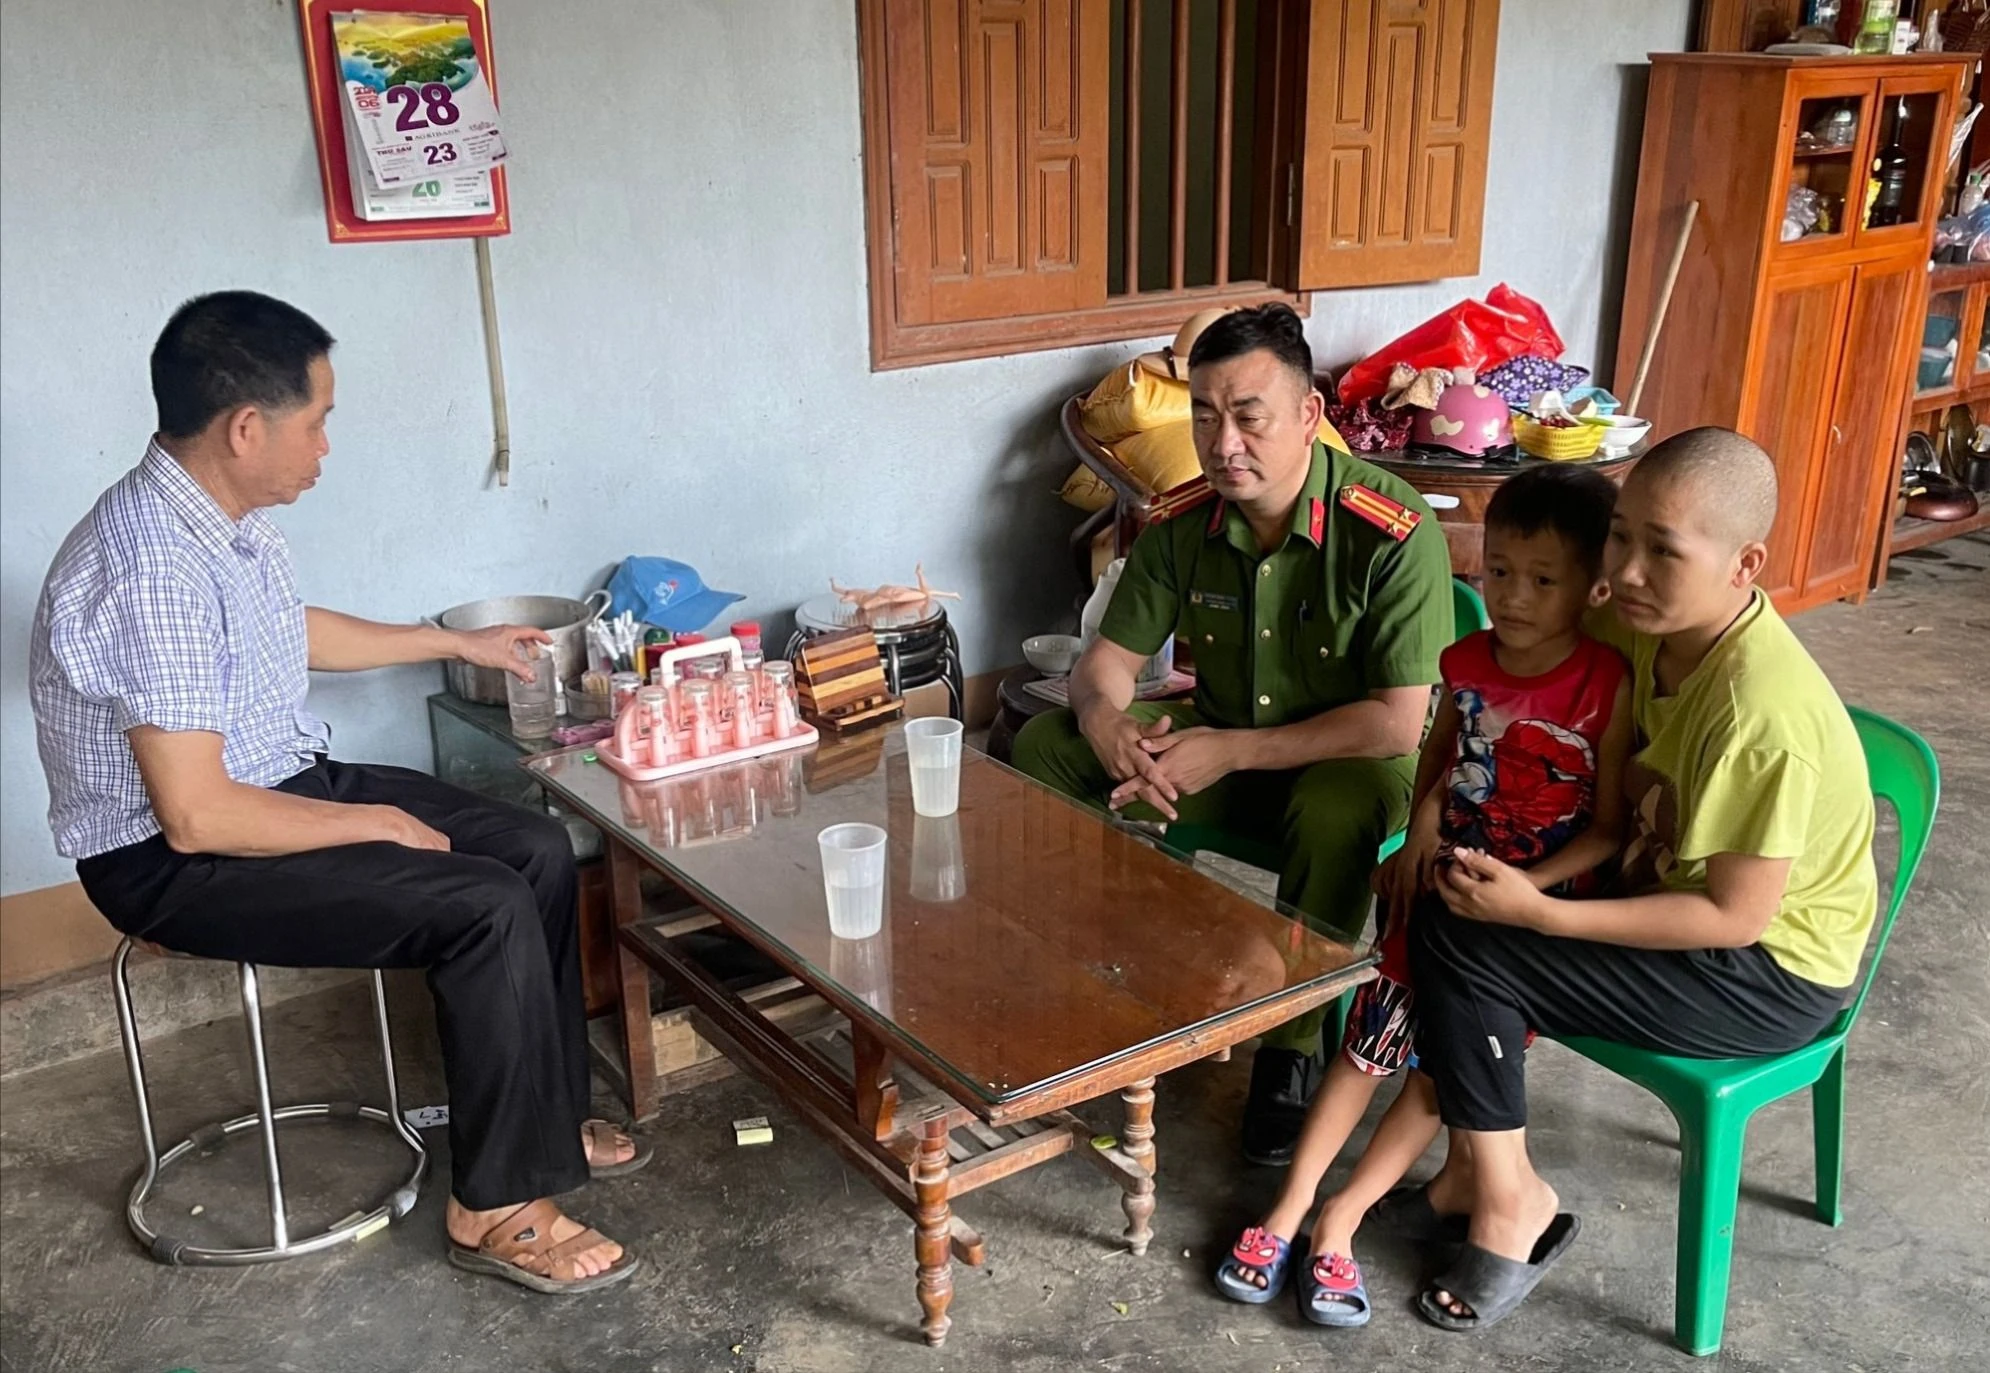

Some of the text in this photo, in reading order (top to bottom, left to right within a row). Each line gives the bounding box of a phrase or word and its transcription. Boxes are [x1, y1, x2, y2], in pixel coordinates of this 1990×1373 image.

[386, 82, 460, 132] 28
[423, 142, 457, 165] 23
[412, 180, 442, 198] 20
